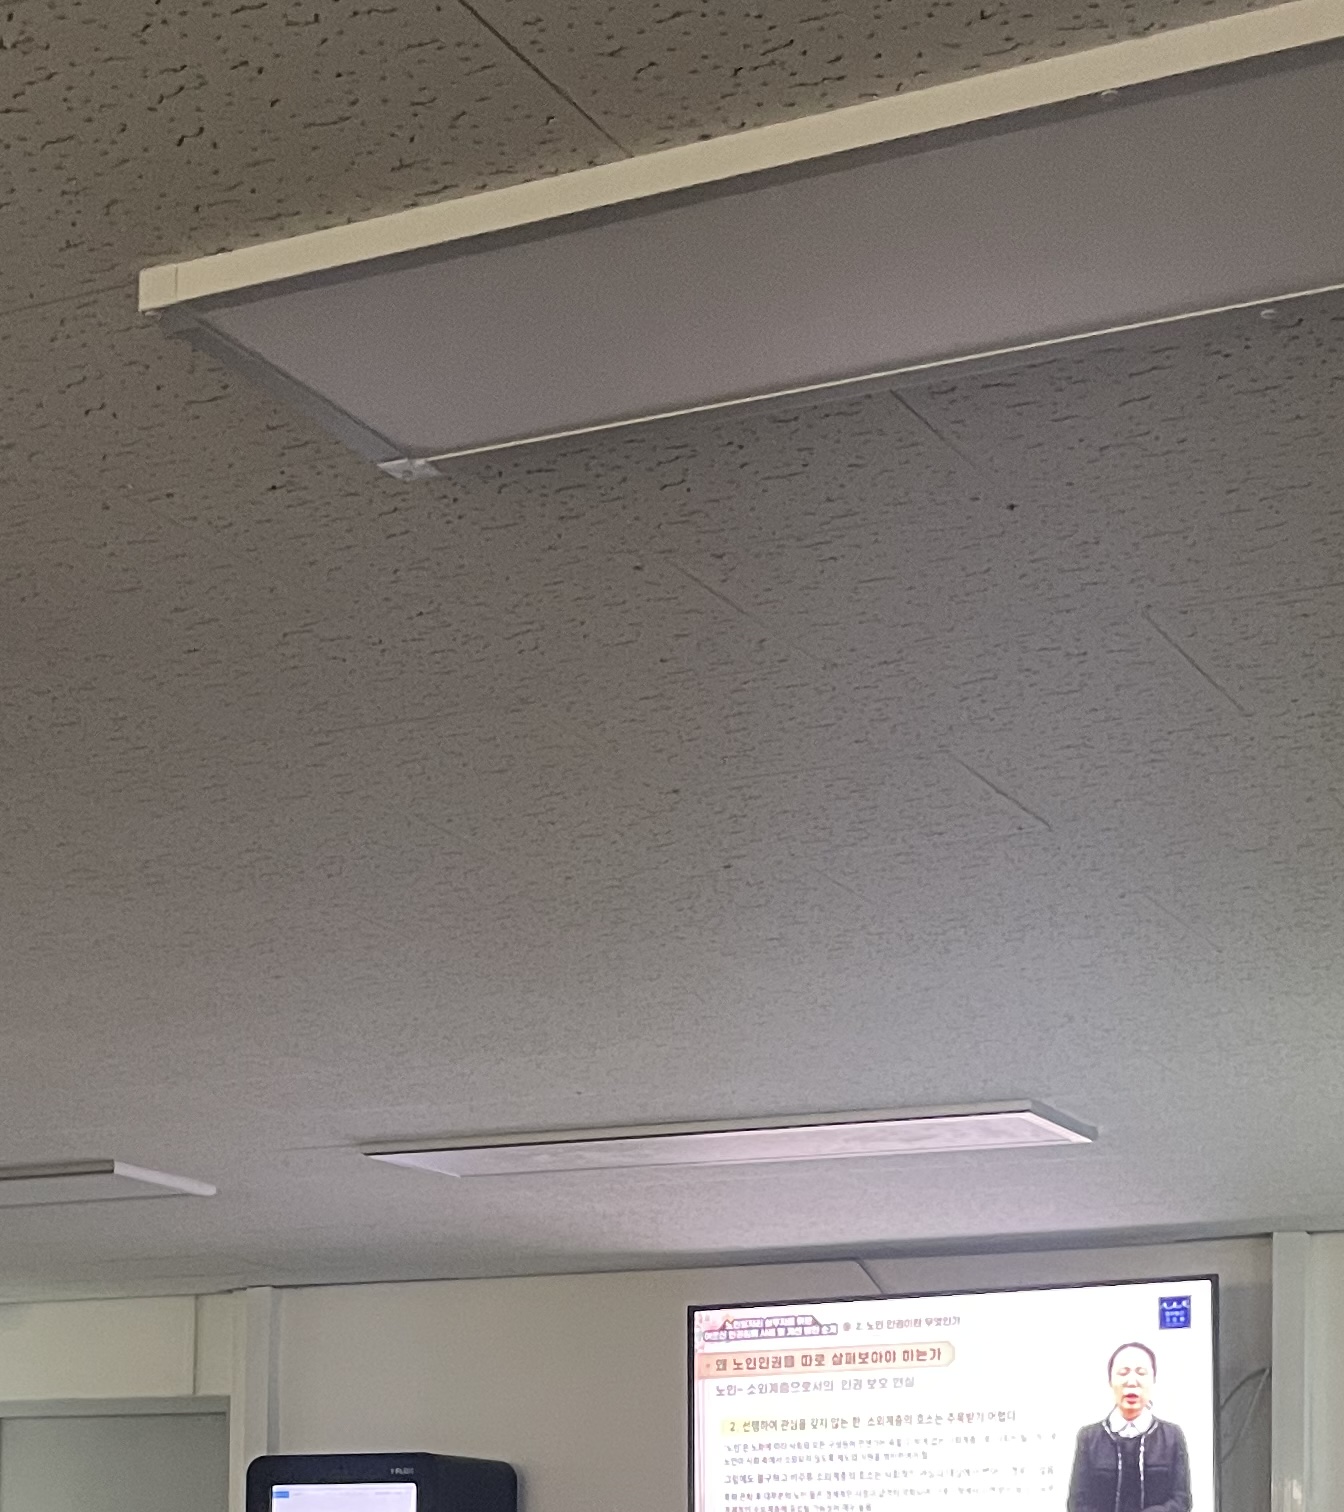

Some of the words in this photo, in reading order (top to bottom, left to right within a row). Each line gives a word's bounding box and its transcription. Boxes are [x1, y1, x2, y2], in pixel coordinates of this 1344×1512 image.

[801, 1353, 826, 1368] 따로
[841, 1378, 863, 1391] 인권
[867, 1377, 889, 1390] 보호
